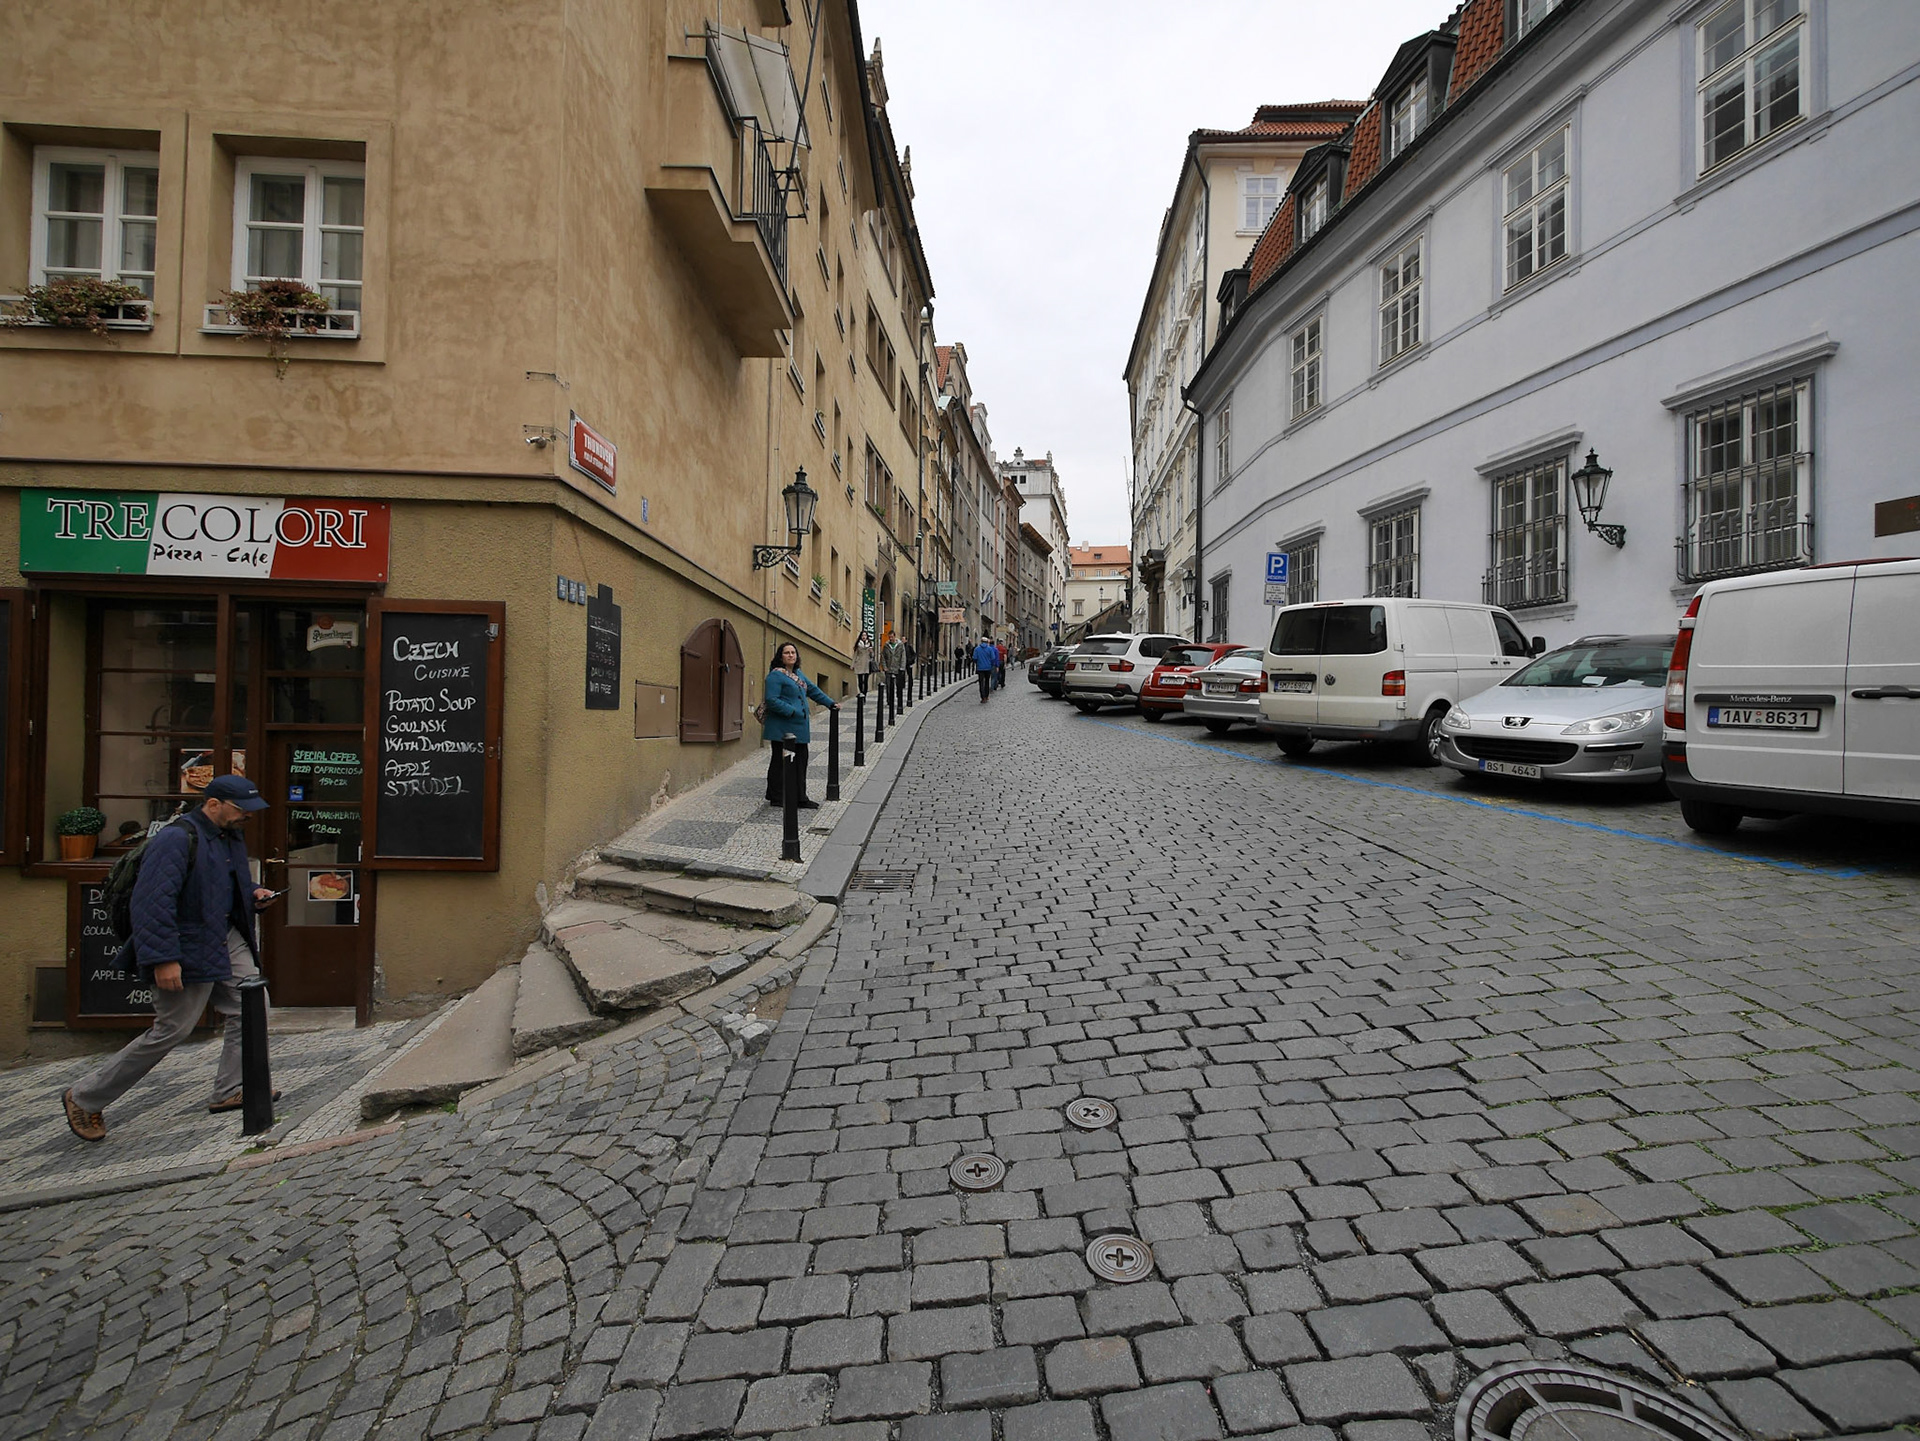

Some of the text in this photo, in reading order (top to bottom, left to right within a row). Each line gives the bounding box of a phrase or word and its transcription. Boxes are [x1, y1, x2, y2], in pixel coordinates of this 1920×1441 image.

[47, 497, 367, 549] TRE COLORI
[153, 543, 203, 563] Pizza
[227, 546, 269, 567] Cafe
[1270, 556, 1284, 574] P
[392, 636, 460, 662] CZECH
[414, 664, 470, 681] CUISINE
[385, 688, 476, 713] POTATO SOUP
[1729, 694, 1792, 703] Mercedes-Benz
[386, 716, 448, 734] GOULASH
[1723, 710, 1752, 724] 1AV
[1766, 711, 1809, 726] 8631
[384, 736, 420, 753] WITH
[294, 750, 360, 763] SPECIAL OFFER
[290, 765, 312, 774] PIZZA
[384, 760, 431, 777] APPLE
[1486, 762, 1536, 776] 8S1 4643
[384, 776, 470, 797] STRUDEL
[291, 810, 314, 820] PIZZA
[82, 924, 116, 936] GOULA
[91, 970, 126, 981] APPLE
